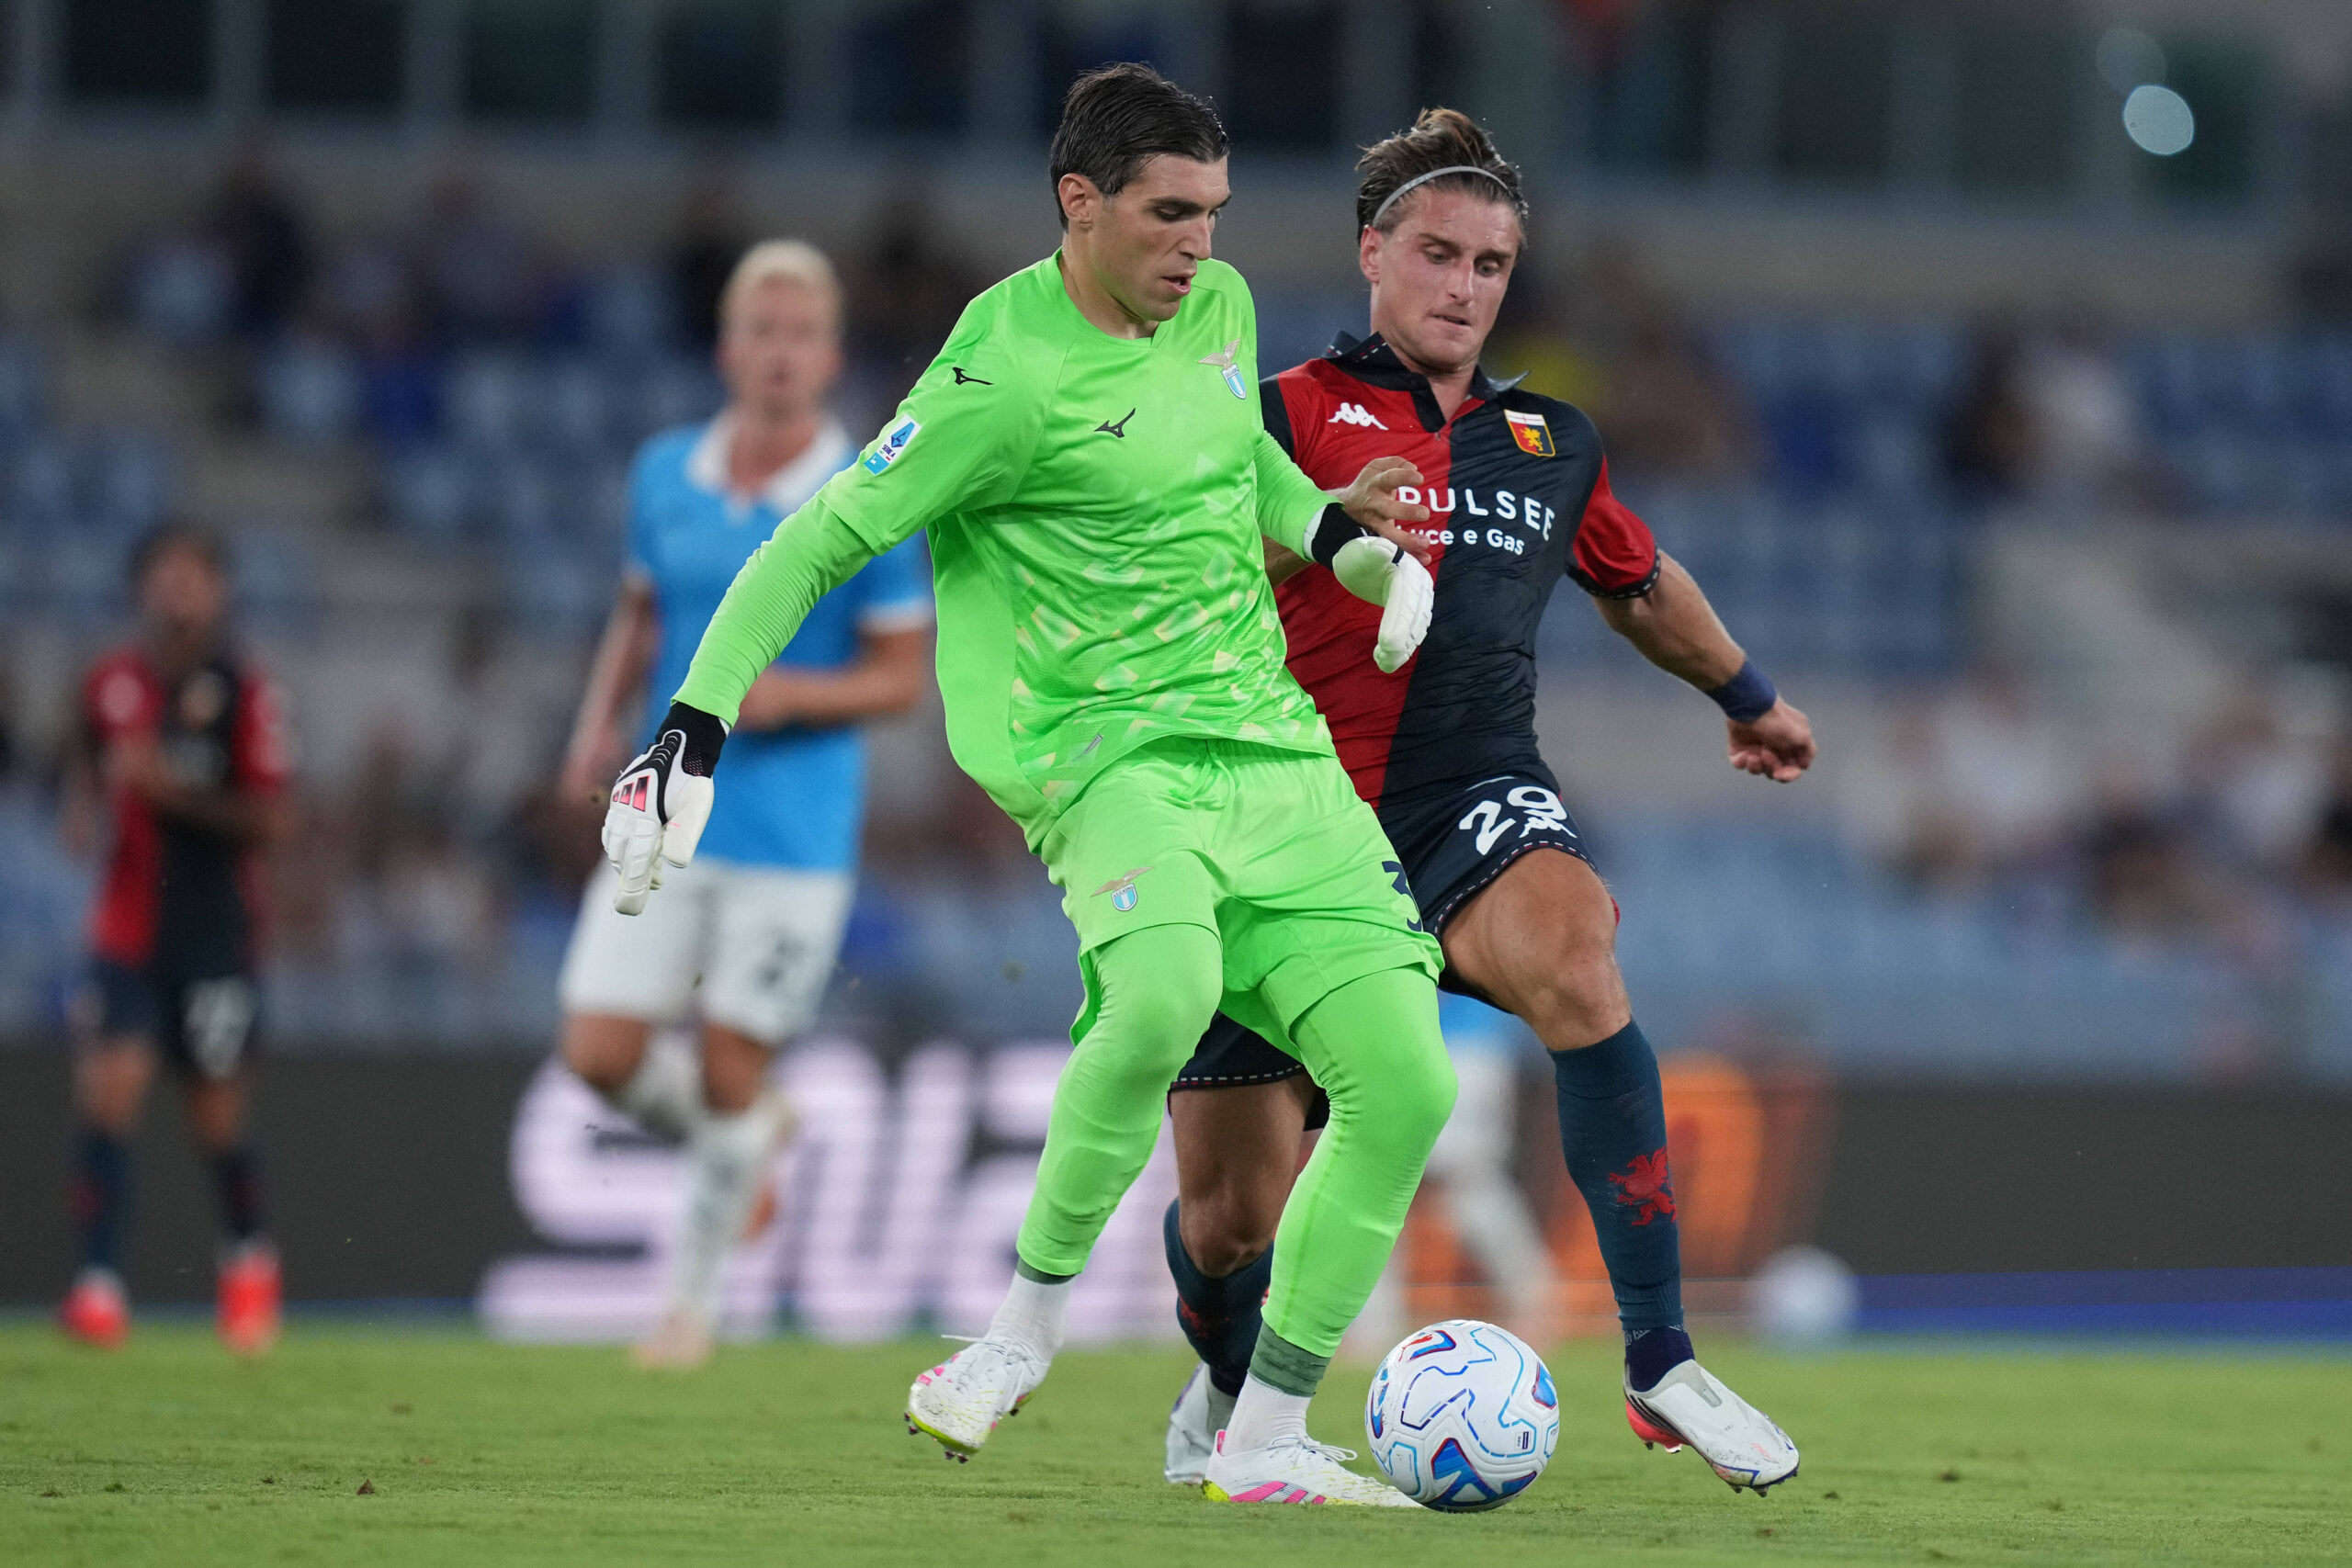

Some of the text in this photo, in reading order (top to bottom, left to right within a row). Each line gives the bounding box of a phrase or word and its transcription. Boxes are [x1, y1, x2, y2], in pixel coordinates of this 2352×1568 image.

[1463, 529, 1478, 545] e
[1486, 528, 1525, 555] Gas
[1459, 785, 1568, 856] 29
